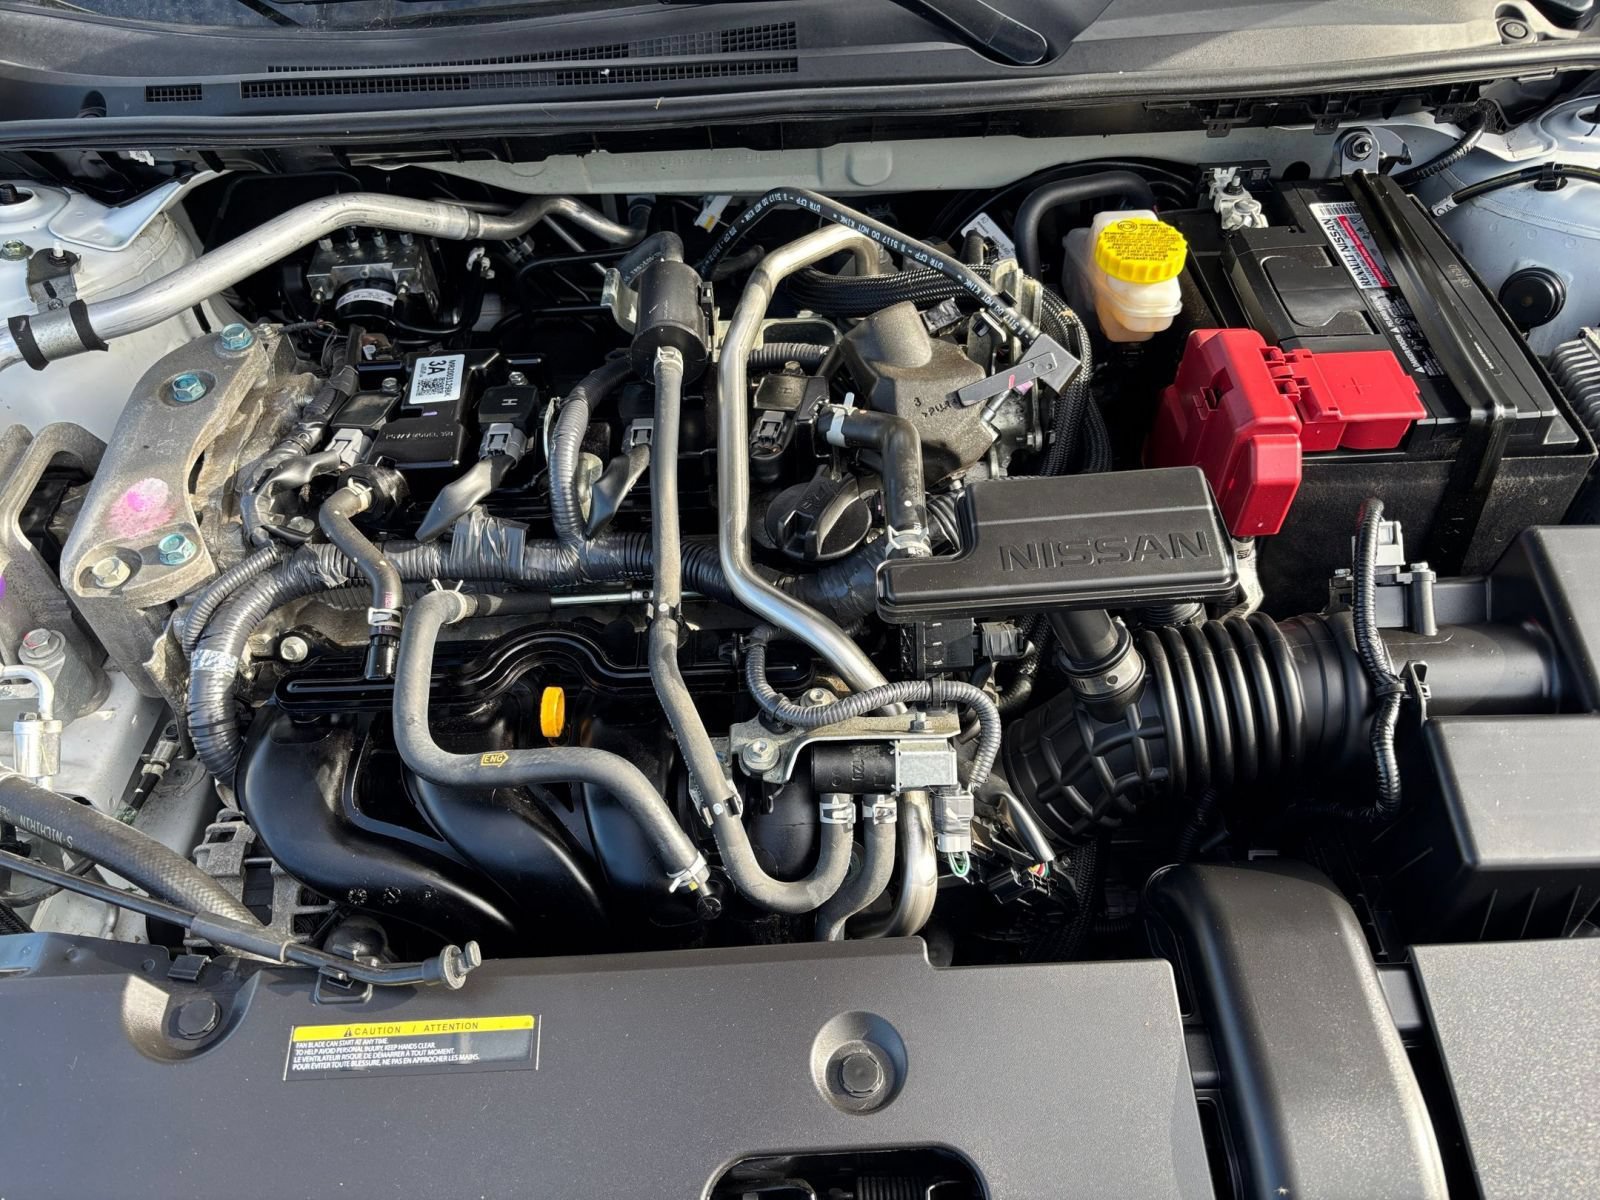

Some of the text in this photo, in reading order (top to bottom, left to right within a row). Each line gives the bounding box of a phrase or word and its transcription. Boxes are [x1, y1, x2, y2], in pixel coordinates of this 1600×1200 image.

[840, 215, 856, 228] KINK
[858, 224, 870, 234] NOT
[871, 230, 880, 240] DO
[1322, 218, 1350, 252] NISSAN
[882, 235, 898, 248] 5117
[915, 251, 928, 262] CFP
[929, 258, 944, 270] DTR
[1344, 254, 1372, 286] RENAULT
[964, 278, 982, 295] KINK
[981, 294, 994, 306] NOT
[1004, 315, 1020, 330] 5117
[427, 360, 447, 375] 3A
[999, 531, 1212, 572] NISSAN
[484, 754, 502, 762] ENG
[354, 1026, 401, 1036] CAUTION
[424, 1022, 479, 1032] ATTENTION
[296, 1048, 304, 1056] TO
[336, 1046, 364, 1054] PERSONAL
[302, 1054, 341, 1062] VENTILATEUR
[331, 1060, 350, 1068] TOUTE
[412, 1056, 448, 1064] APPROCHER
